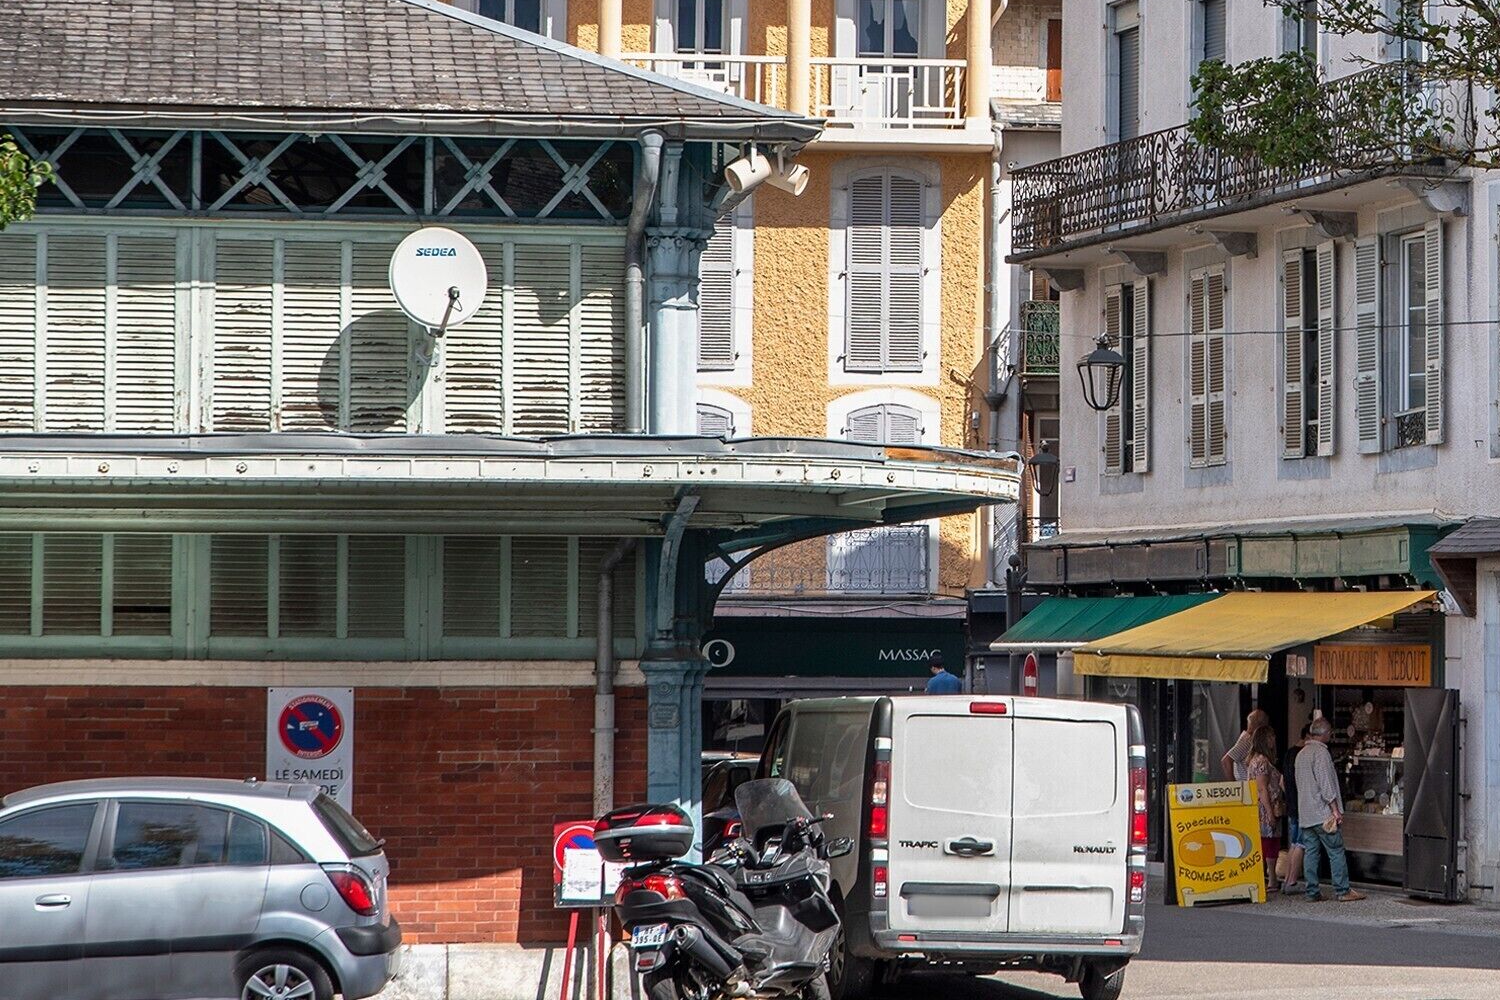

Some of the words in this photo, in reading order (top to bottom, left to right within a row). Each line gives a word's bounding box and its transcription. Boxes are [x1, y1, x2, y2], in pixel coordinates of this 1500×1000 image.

[416, 247, 457, 257] SEDEA
[1319, 650, 1379, 681] FROMAGERIE
[1387, 650, 1427, 681] NEBOUT
[287, 695, 335, 711] STATIONNEMENT
[275, 769, 291, 781] LE
[293, 769, 344, 781] SAMEDI
[1195, 788, 1204, 799] S.
[1206, 786, 1241, 799] NEBOUT
[899, 840, 938, 849] TRAFIC
[1072, 845, 1116, 854] RENAULT
[1178, 866, 1226, 883] FROMAGE
[1228, 869, 1239, 879] du
[1240, 850, 1262, 873] PAYS
